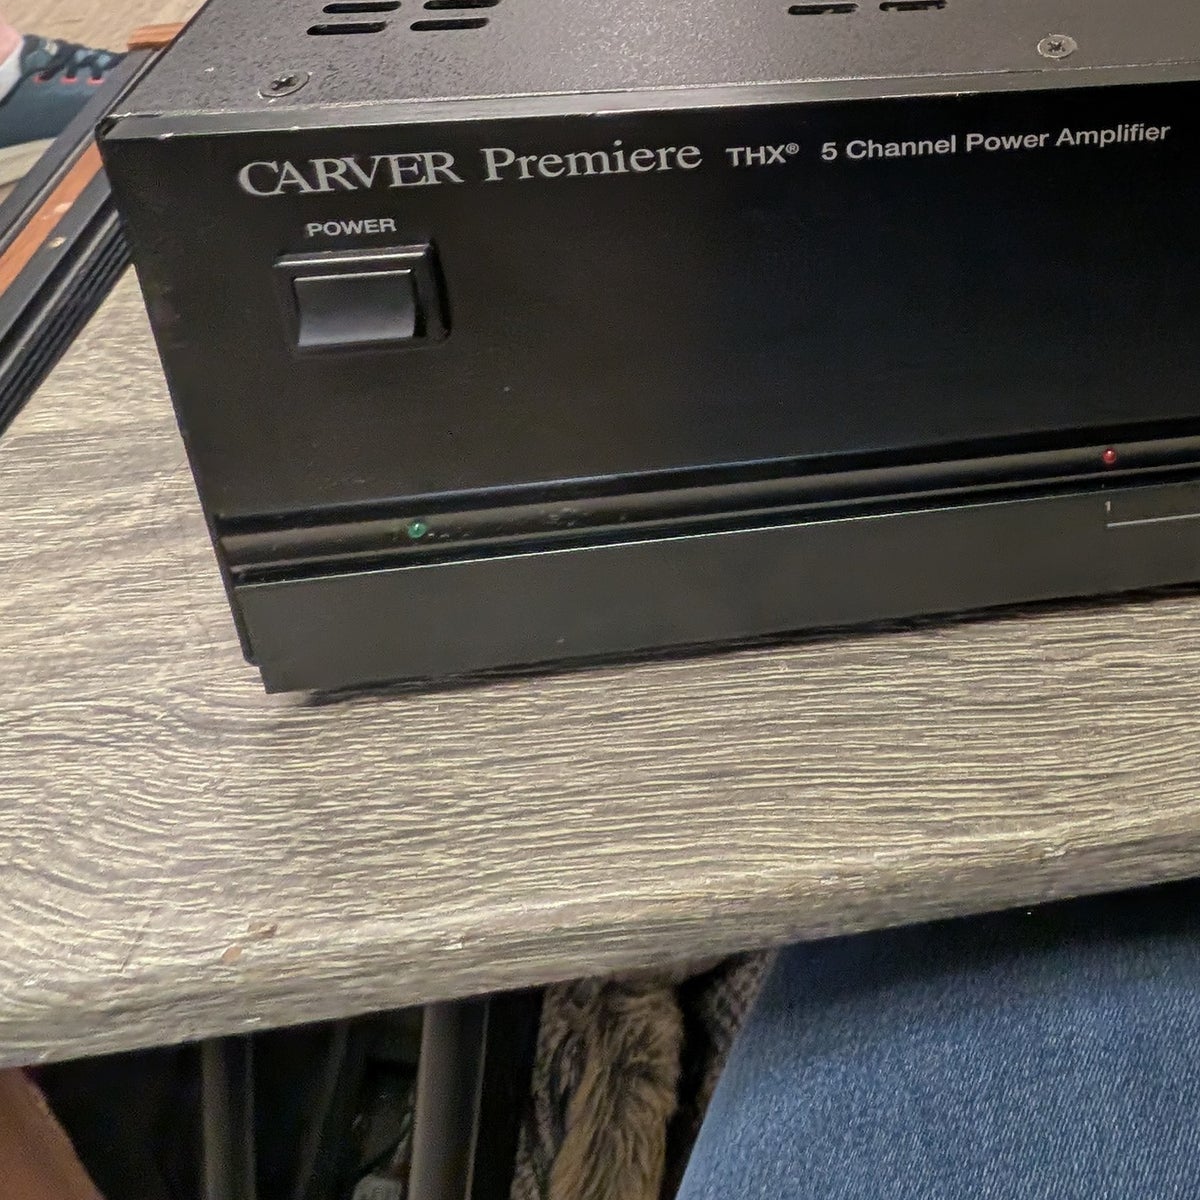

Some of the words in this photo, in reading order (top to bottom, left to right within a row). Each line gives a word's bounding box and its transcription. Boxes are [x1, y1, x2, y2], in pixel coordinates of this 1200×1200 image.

[237, 152, 463, 197] CARVER
[479, 140, 704, 182] Premiere
[820, 140, 839, 162] 5
[846, 134, 957, 160] Channel
[965, 130, 1051, 153] Power
[1055, 123, 1171, 147] Amplifier
[306, 218, 397, 237] POWER
[1104, 499, 1113, 513] 1
